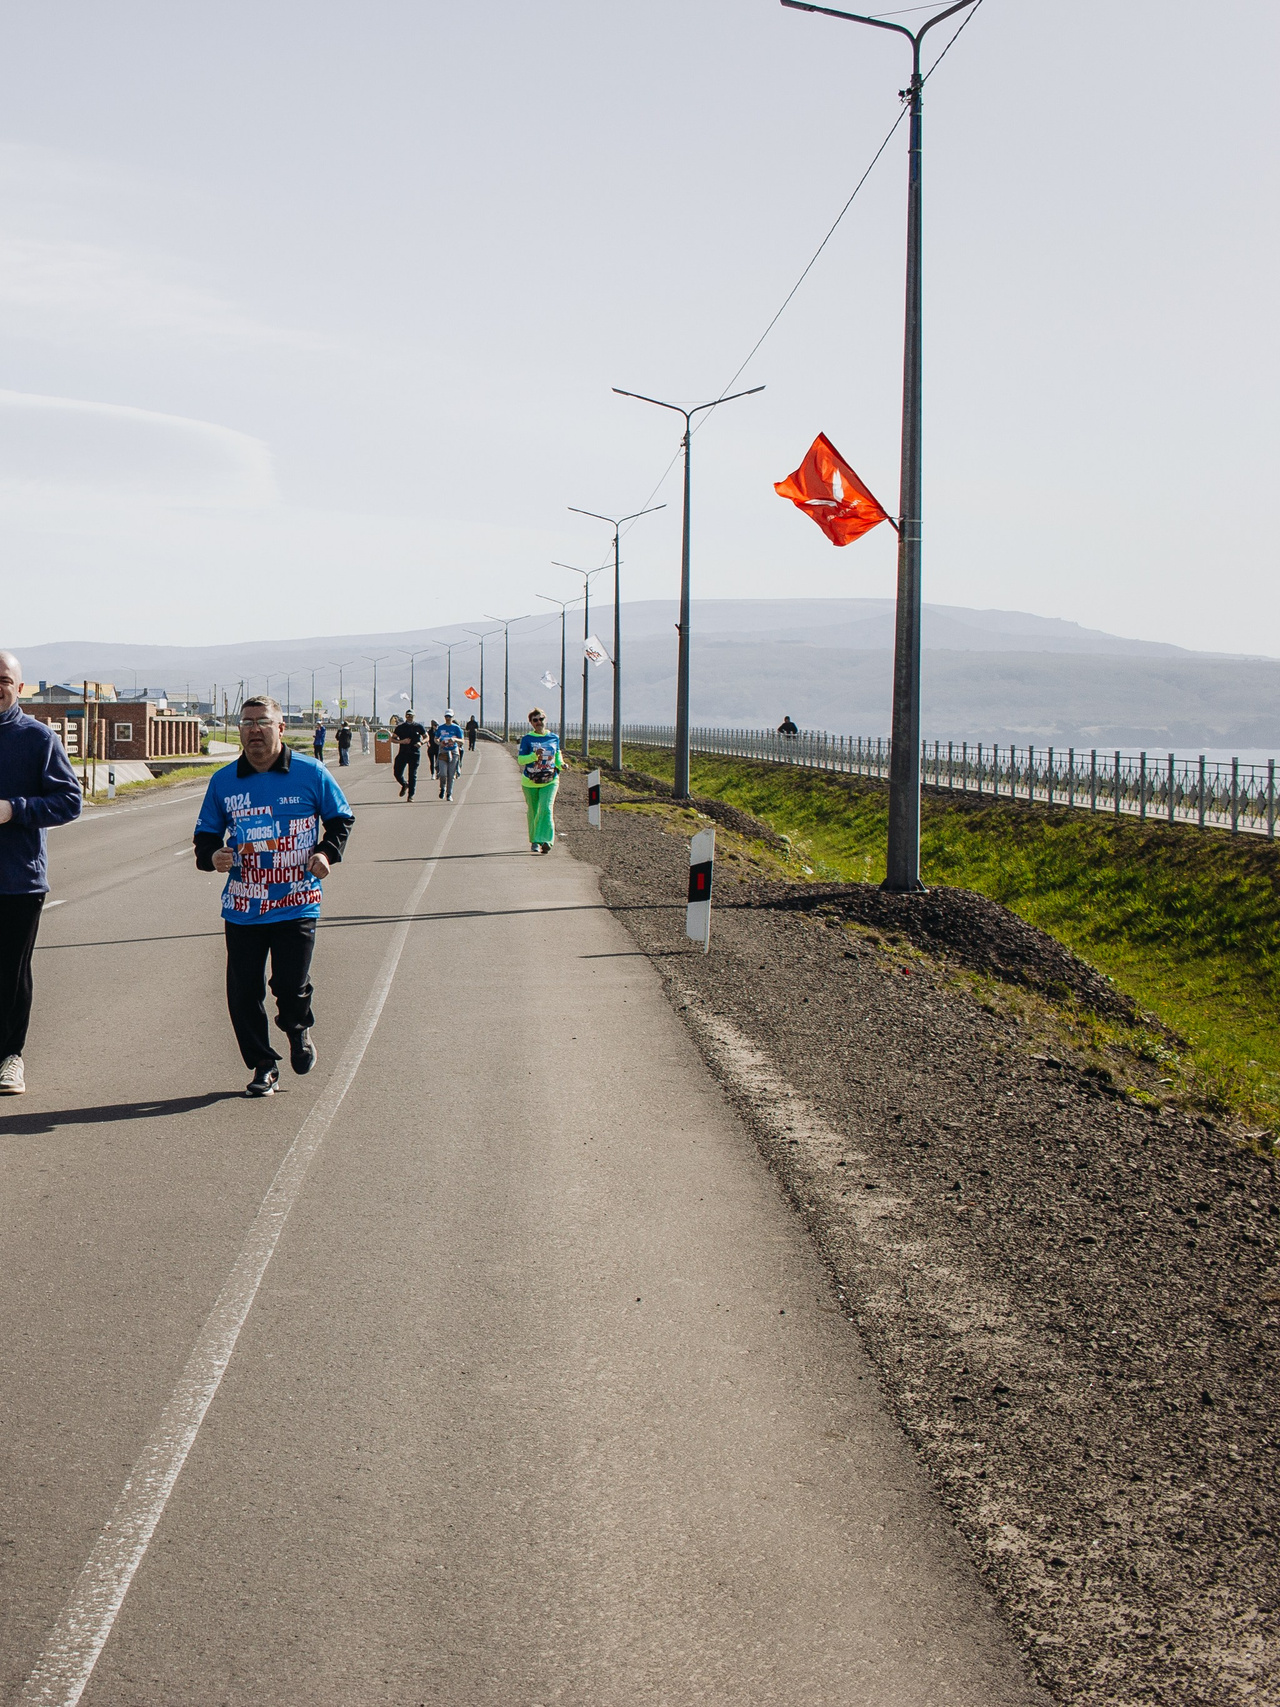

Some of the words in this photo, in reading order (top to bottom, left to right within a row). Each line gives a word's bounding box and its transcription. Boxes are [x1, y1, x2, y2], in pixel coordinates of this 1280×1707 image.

[224, 792, 251, 812] 2024
[246, 826, 273, 841] 20035
[240, 865, 305, 884] #ГОРДОСТЬ
